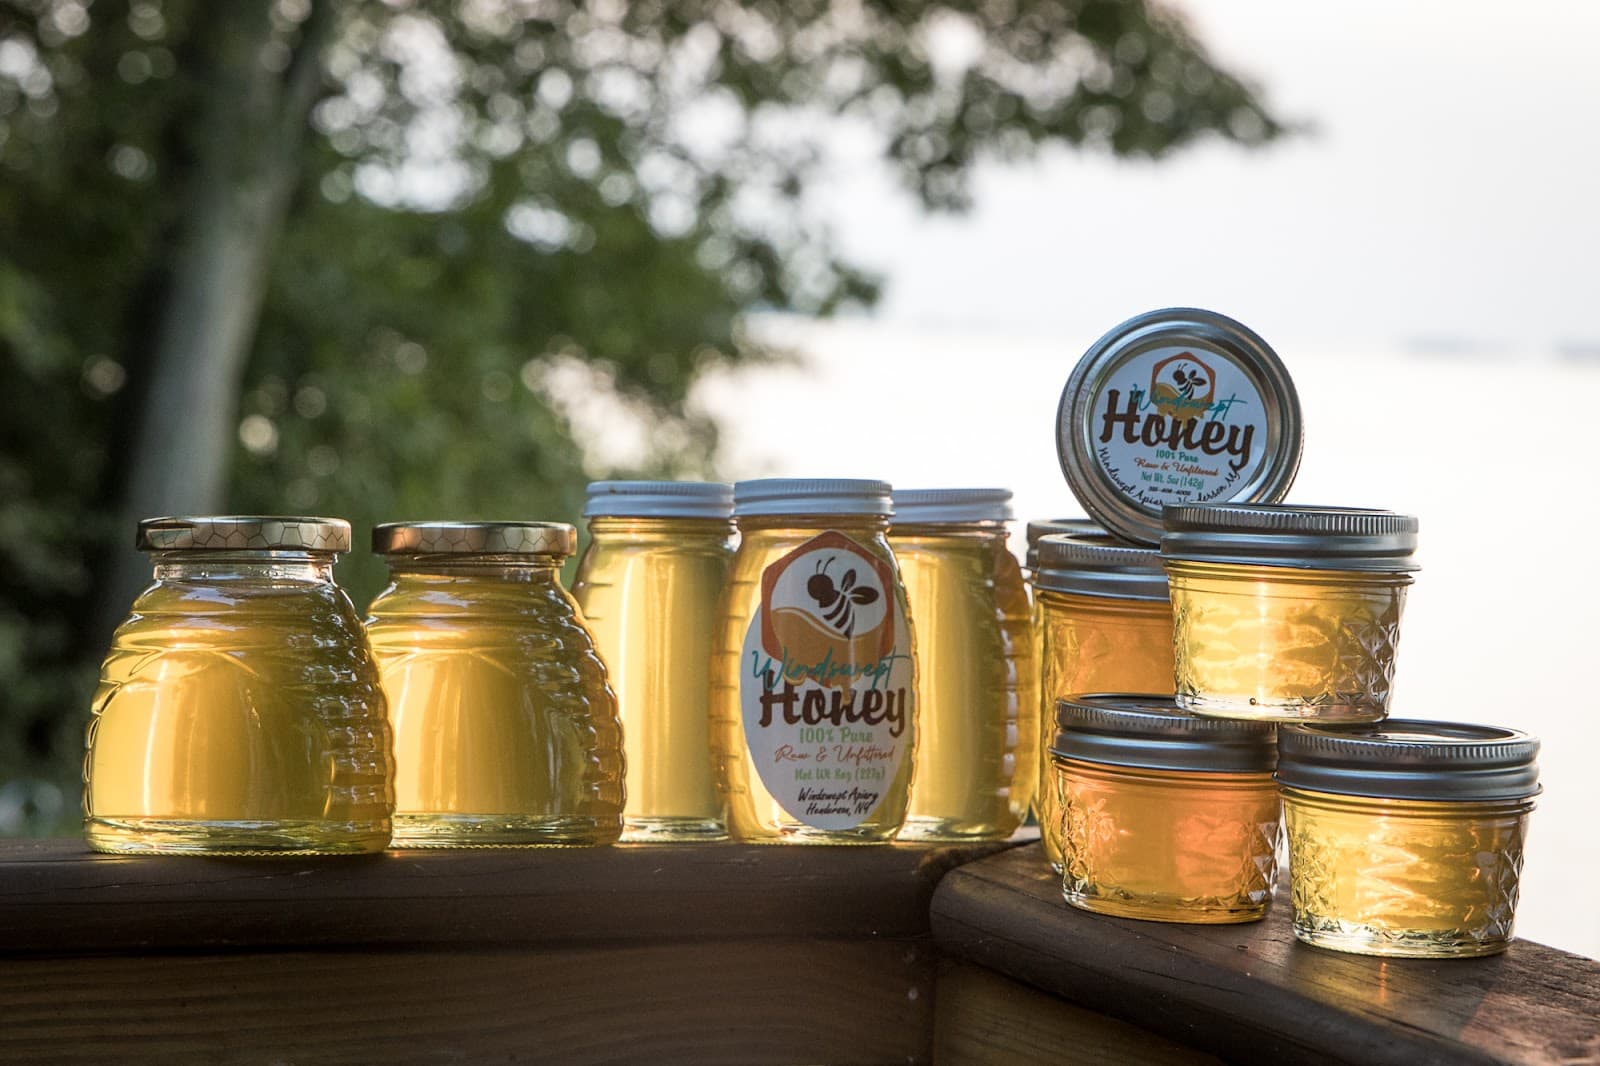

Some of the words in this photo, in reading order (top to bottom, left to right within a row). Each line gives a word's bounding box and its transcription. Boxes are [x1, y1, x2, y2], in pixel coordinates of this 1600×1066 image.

[1099, 389, 1255, 471] Honey
[1178, 451, 1199, 463] Pure
[752, 645, 913, 691] Windswept
[759, 669, 905, 737] Honey
[799, 727, 834, 743] 100%
[841, 726, 875, 743] Pure
[775, 744, 811, 763] Raw
[816, 746, 829, 762] &
[798, 786, 848, 805] Windswept
[848, 786, 879, 805] Apiary
